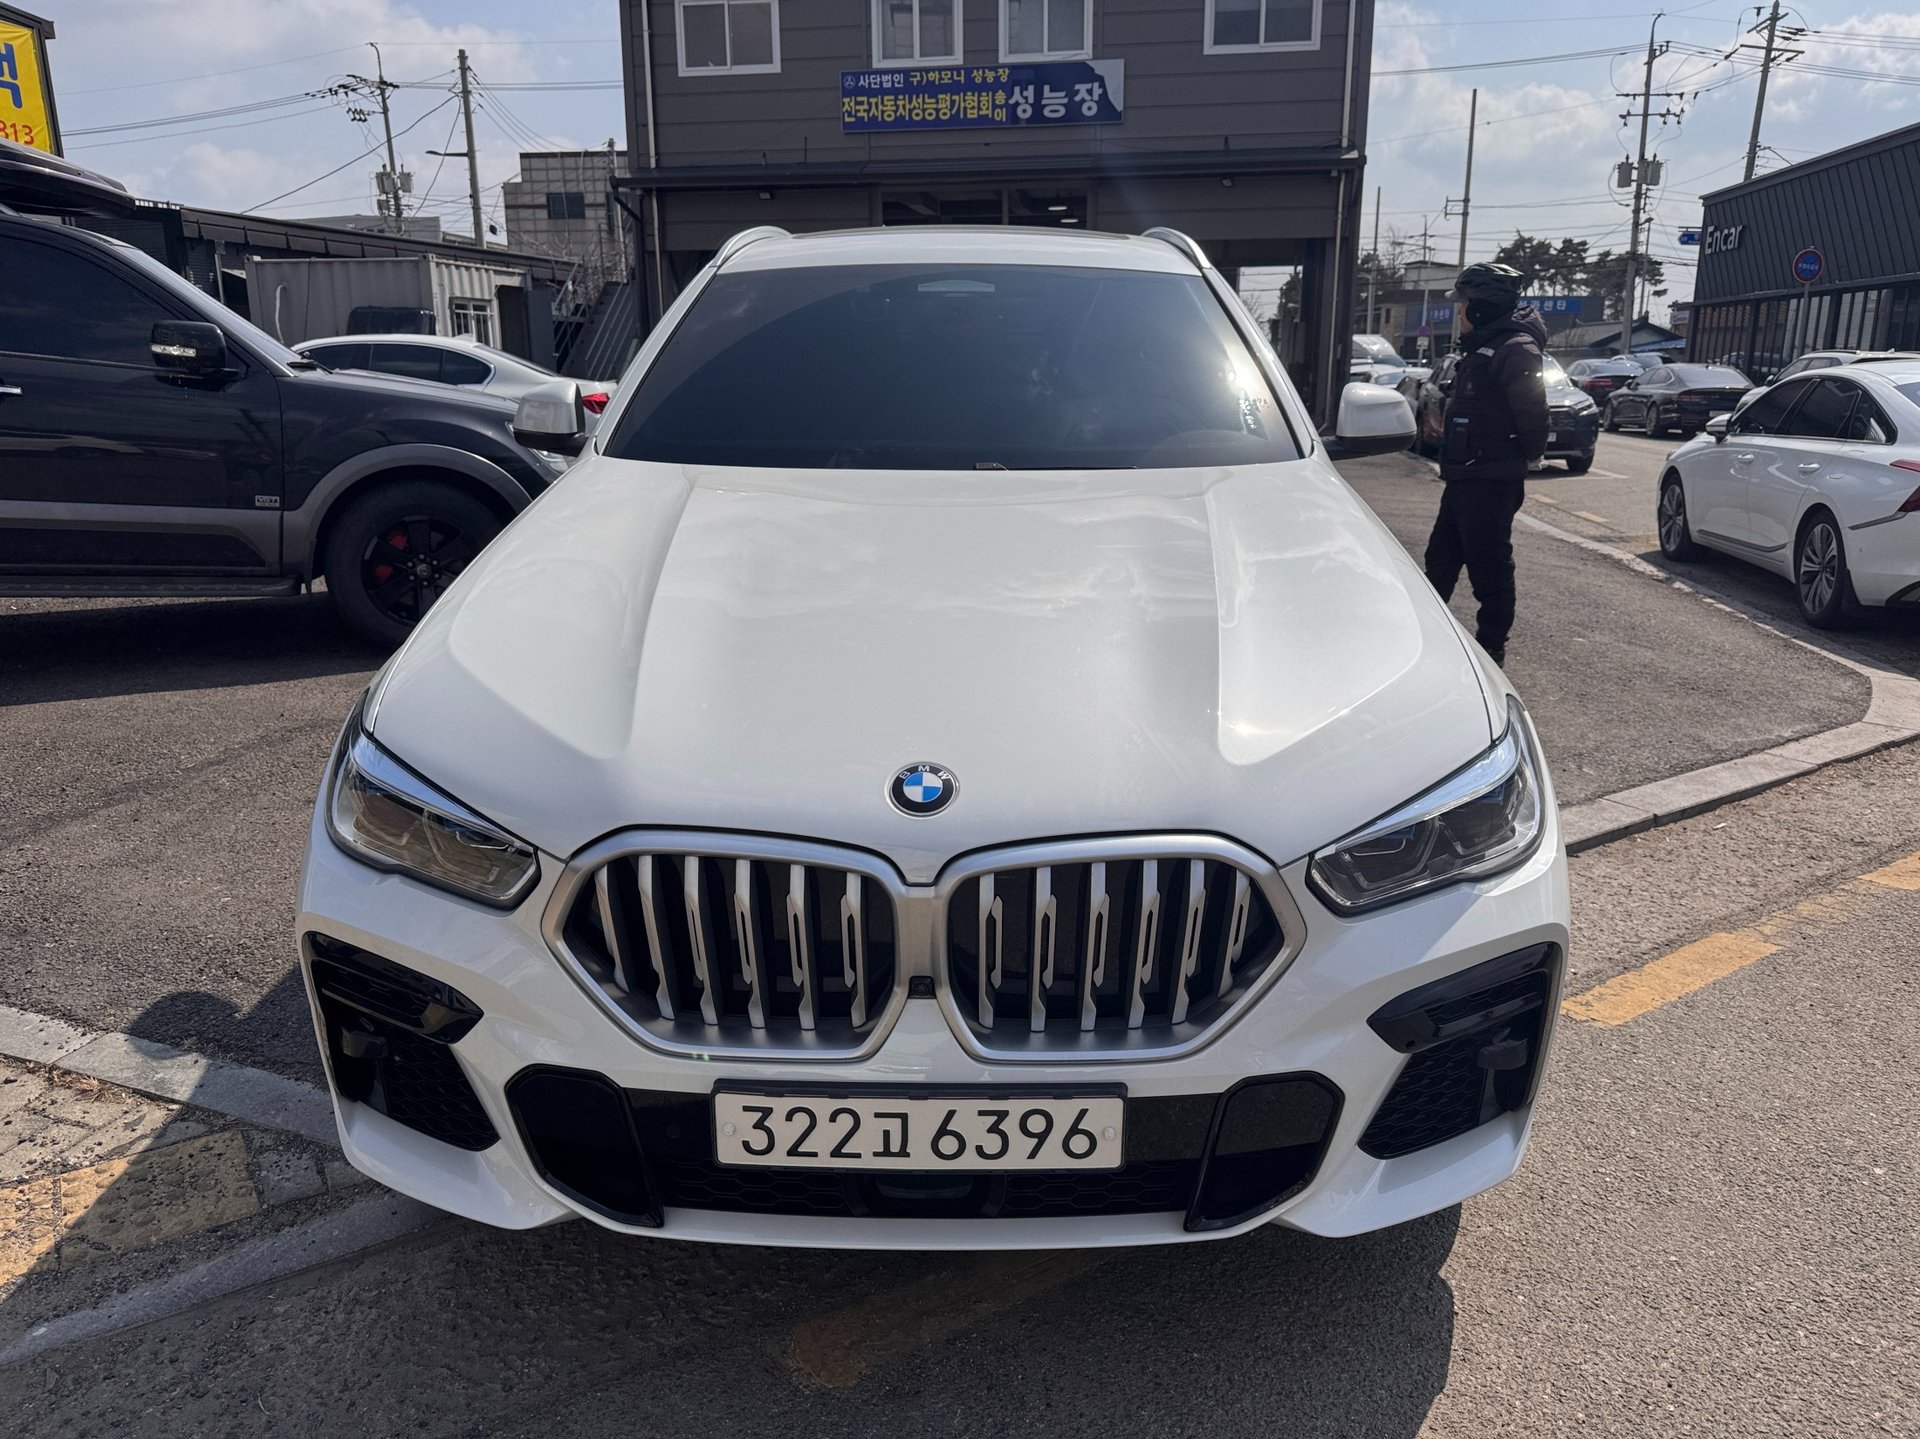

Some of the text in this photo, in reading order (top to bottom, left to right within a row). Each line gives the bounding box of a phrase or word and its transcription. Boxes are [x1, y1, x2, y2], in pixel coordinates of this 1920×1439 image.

[858, 72, 904, 88] 사단법인
[971, 68, 1009, 84] 성능장
[842, 91, 992, 122] 전국자동차성능평가협회
[1008, 82, 1103, 119] 성능장
[1705, 225, 1743, 255] Encar
[899, 765, 949, 780] BMW
